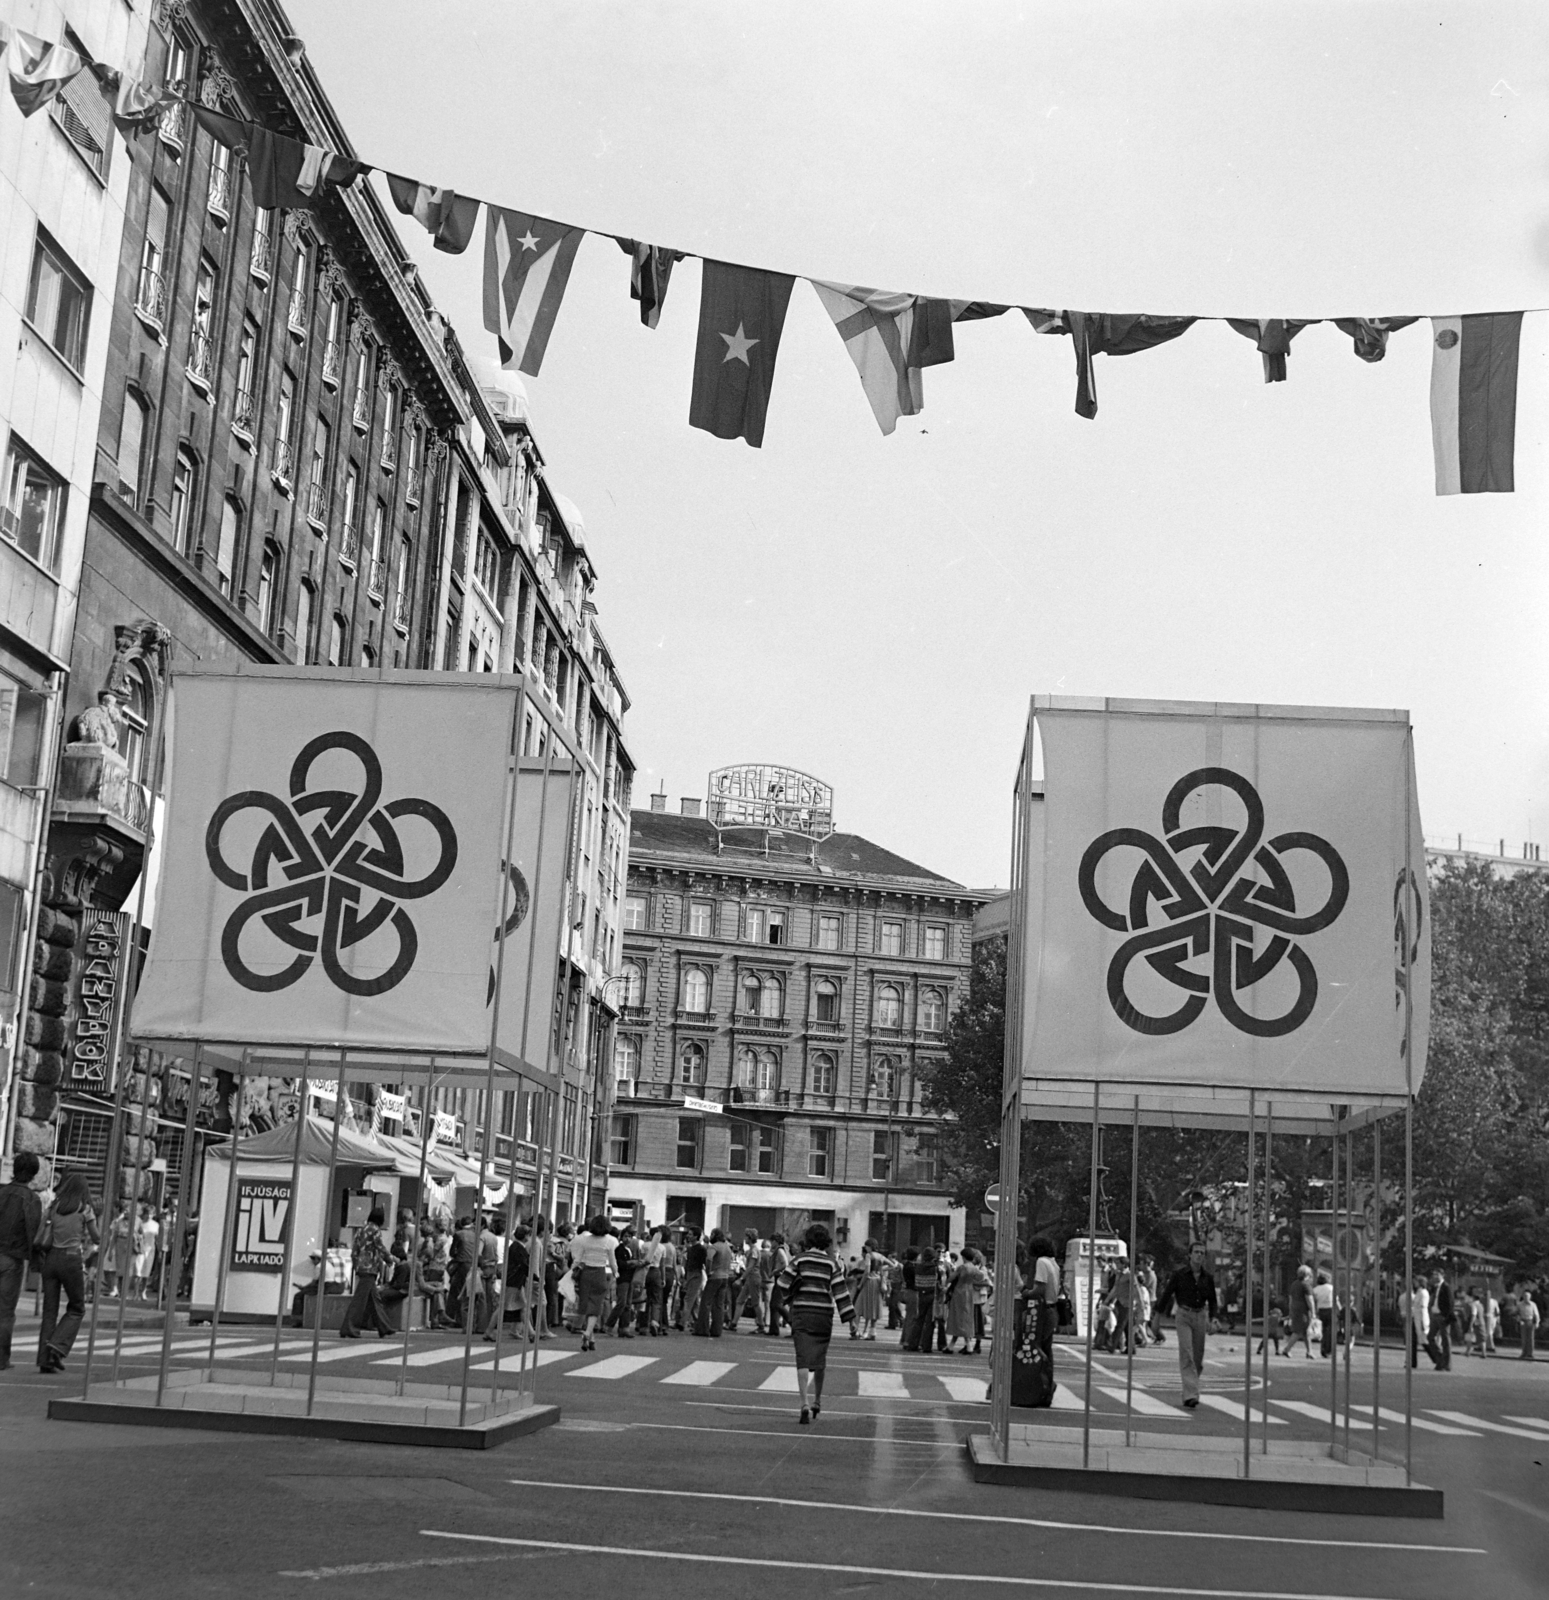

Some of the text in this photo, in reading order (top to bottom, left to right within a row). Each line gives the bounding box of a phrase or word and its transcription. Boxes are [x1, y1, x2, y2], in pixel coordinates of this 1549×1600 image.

[718, 769, 822, 804] CARL ZEISS
[732, 805, 804, 831] JENA
[241, 1185, 291, 1198] IFJÚSÁGI
